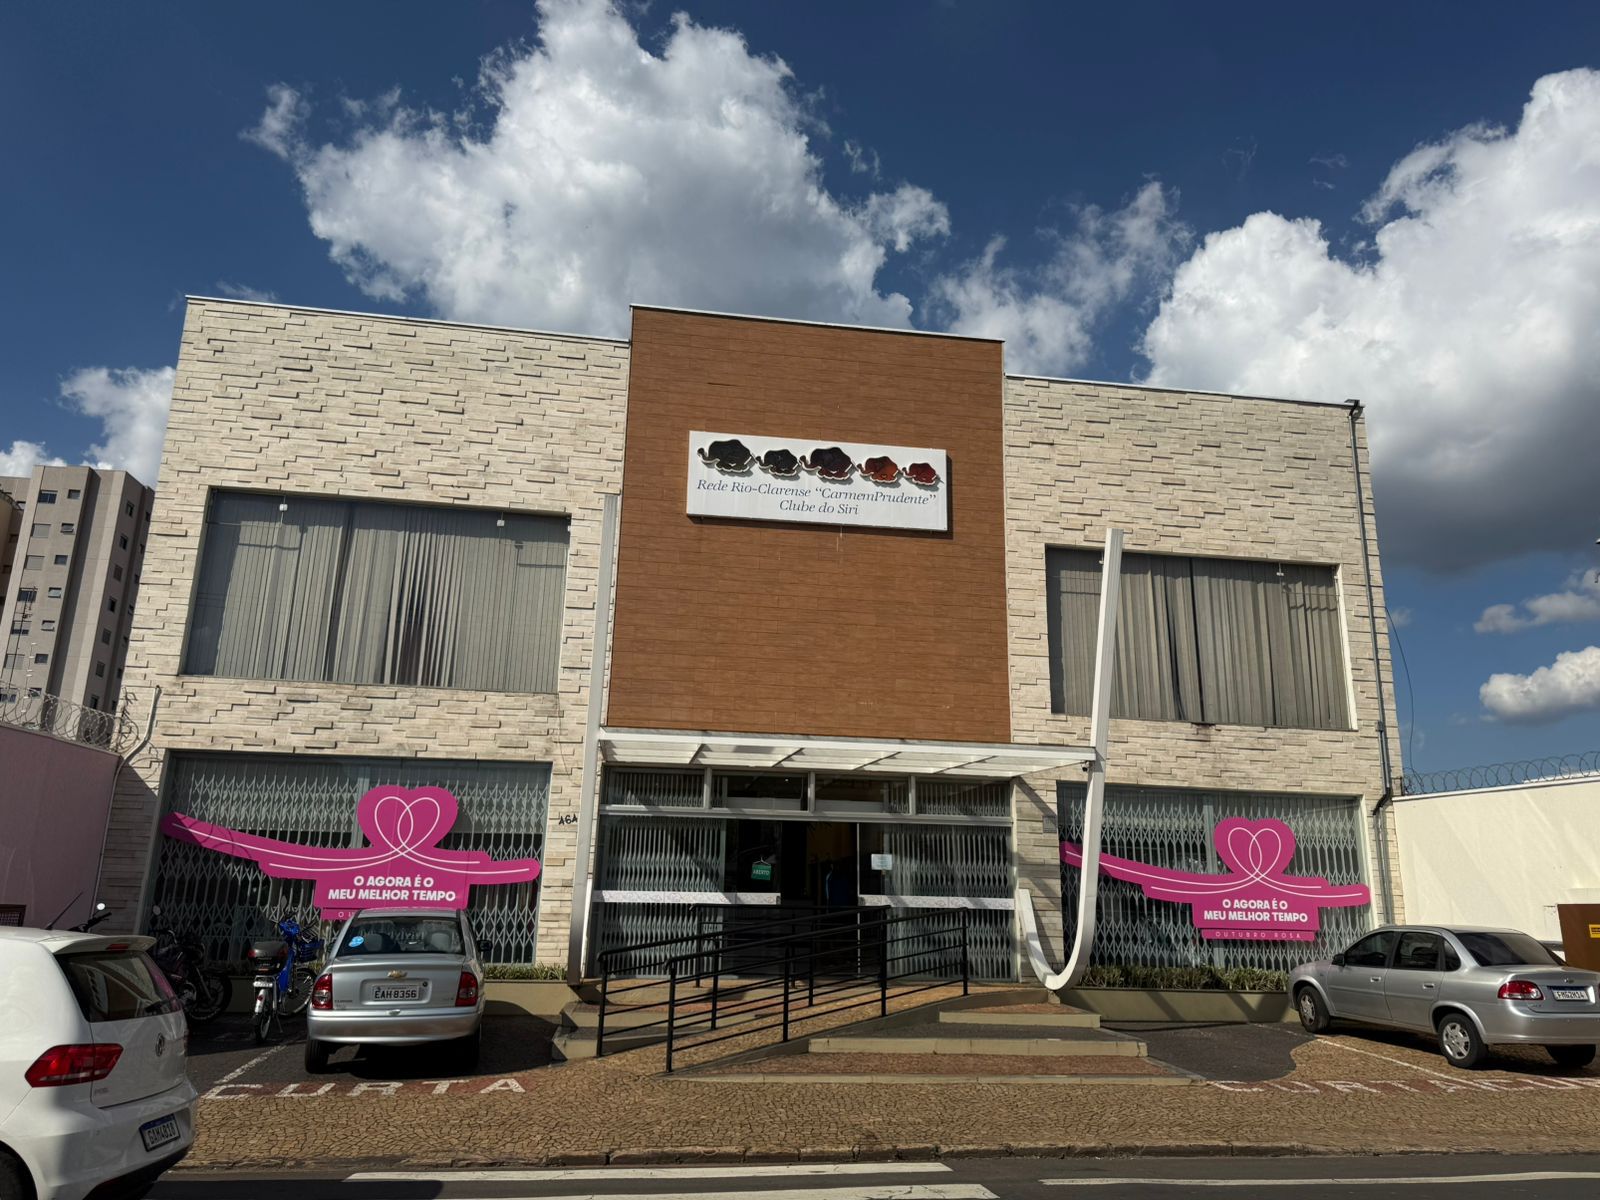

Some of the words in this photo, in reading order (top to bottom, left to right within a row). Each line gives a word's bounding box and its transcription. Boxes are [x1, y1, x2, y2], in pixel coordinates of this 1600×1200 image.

[697, 479, 728, 492] Rede
[731, 481, 811, 497] Rio-Clarense
[780, 499, 815, 512] Clube
[818, 502, 834, 513] do
[837, 503, 858, 515] Siri
[353, 875, 365, 887] O
[366, 876, 412, 888] AGORA
[413, 874, 422, 888] É
[423, 877, 434, 888] O
[328, 889, 356, 900] MEU
[358, 889, 409, 901] MELHOR
[412, 890, 456, 902] TEMPO
[1222, 899, 1231, 908] O
[1233, 899, 1270, 910] AGORA
[1272, 898, 1278, 909] É
[1279, 901, 1288, 910] O
[1204, 910, 1226, 920] MEU
[1228, 911, 1270, 922] MELHOR
[1272, 912, 1308, 922] TEMPO
[374, 990, 417, 999] EAH8356
